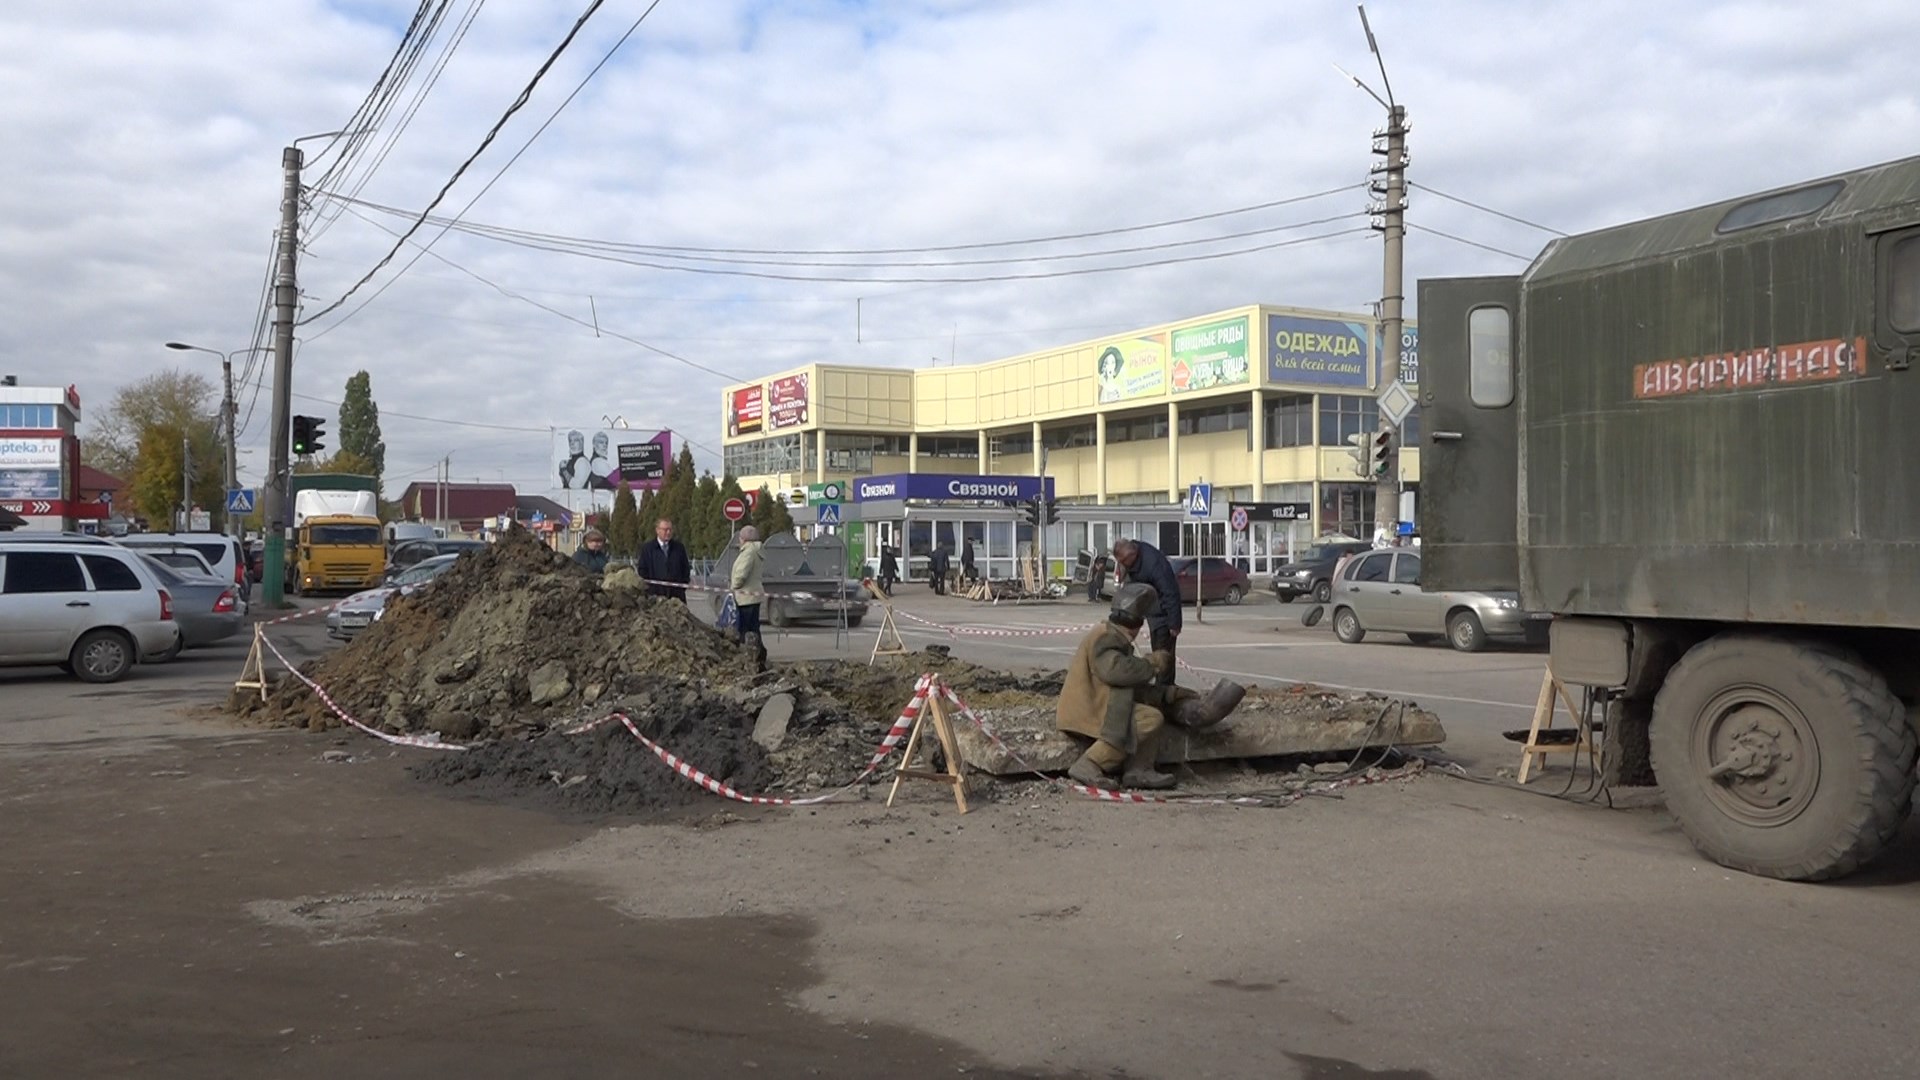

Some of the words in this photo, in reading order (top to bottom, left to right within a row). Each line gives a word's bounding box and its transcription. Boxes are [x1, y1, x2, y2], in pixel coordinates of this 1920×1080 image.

[1174, 332, 1216, 353] ОВОЩНЫЕ
[1217, 325, 1244, 346] РЯДЫ
[1275, 331, 1360, 357] ОДЕЖДА
[1275, 353, 1297, 369] для
[1300, 357, 1326, 371] всей
[1327, 363, 1361, 374] семьи
[1643, 341, 1857, 395] АВАРИЙНАЯ
[861, 481, 896, 498] Связной
[948, 480, 1018, 497] Связной
[1272, 505, 1295, 518] TELE2
